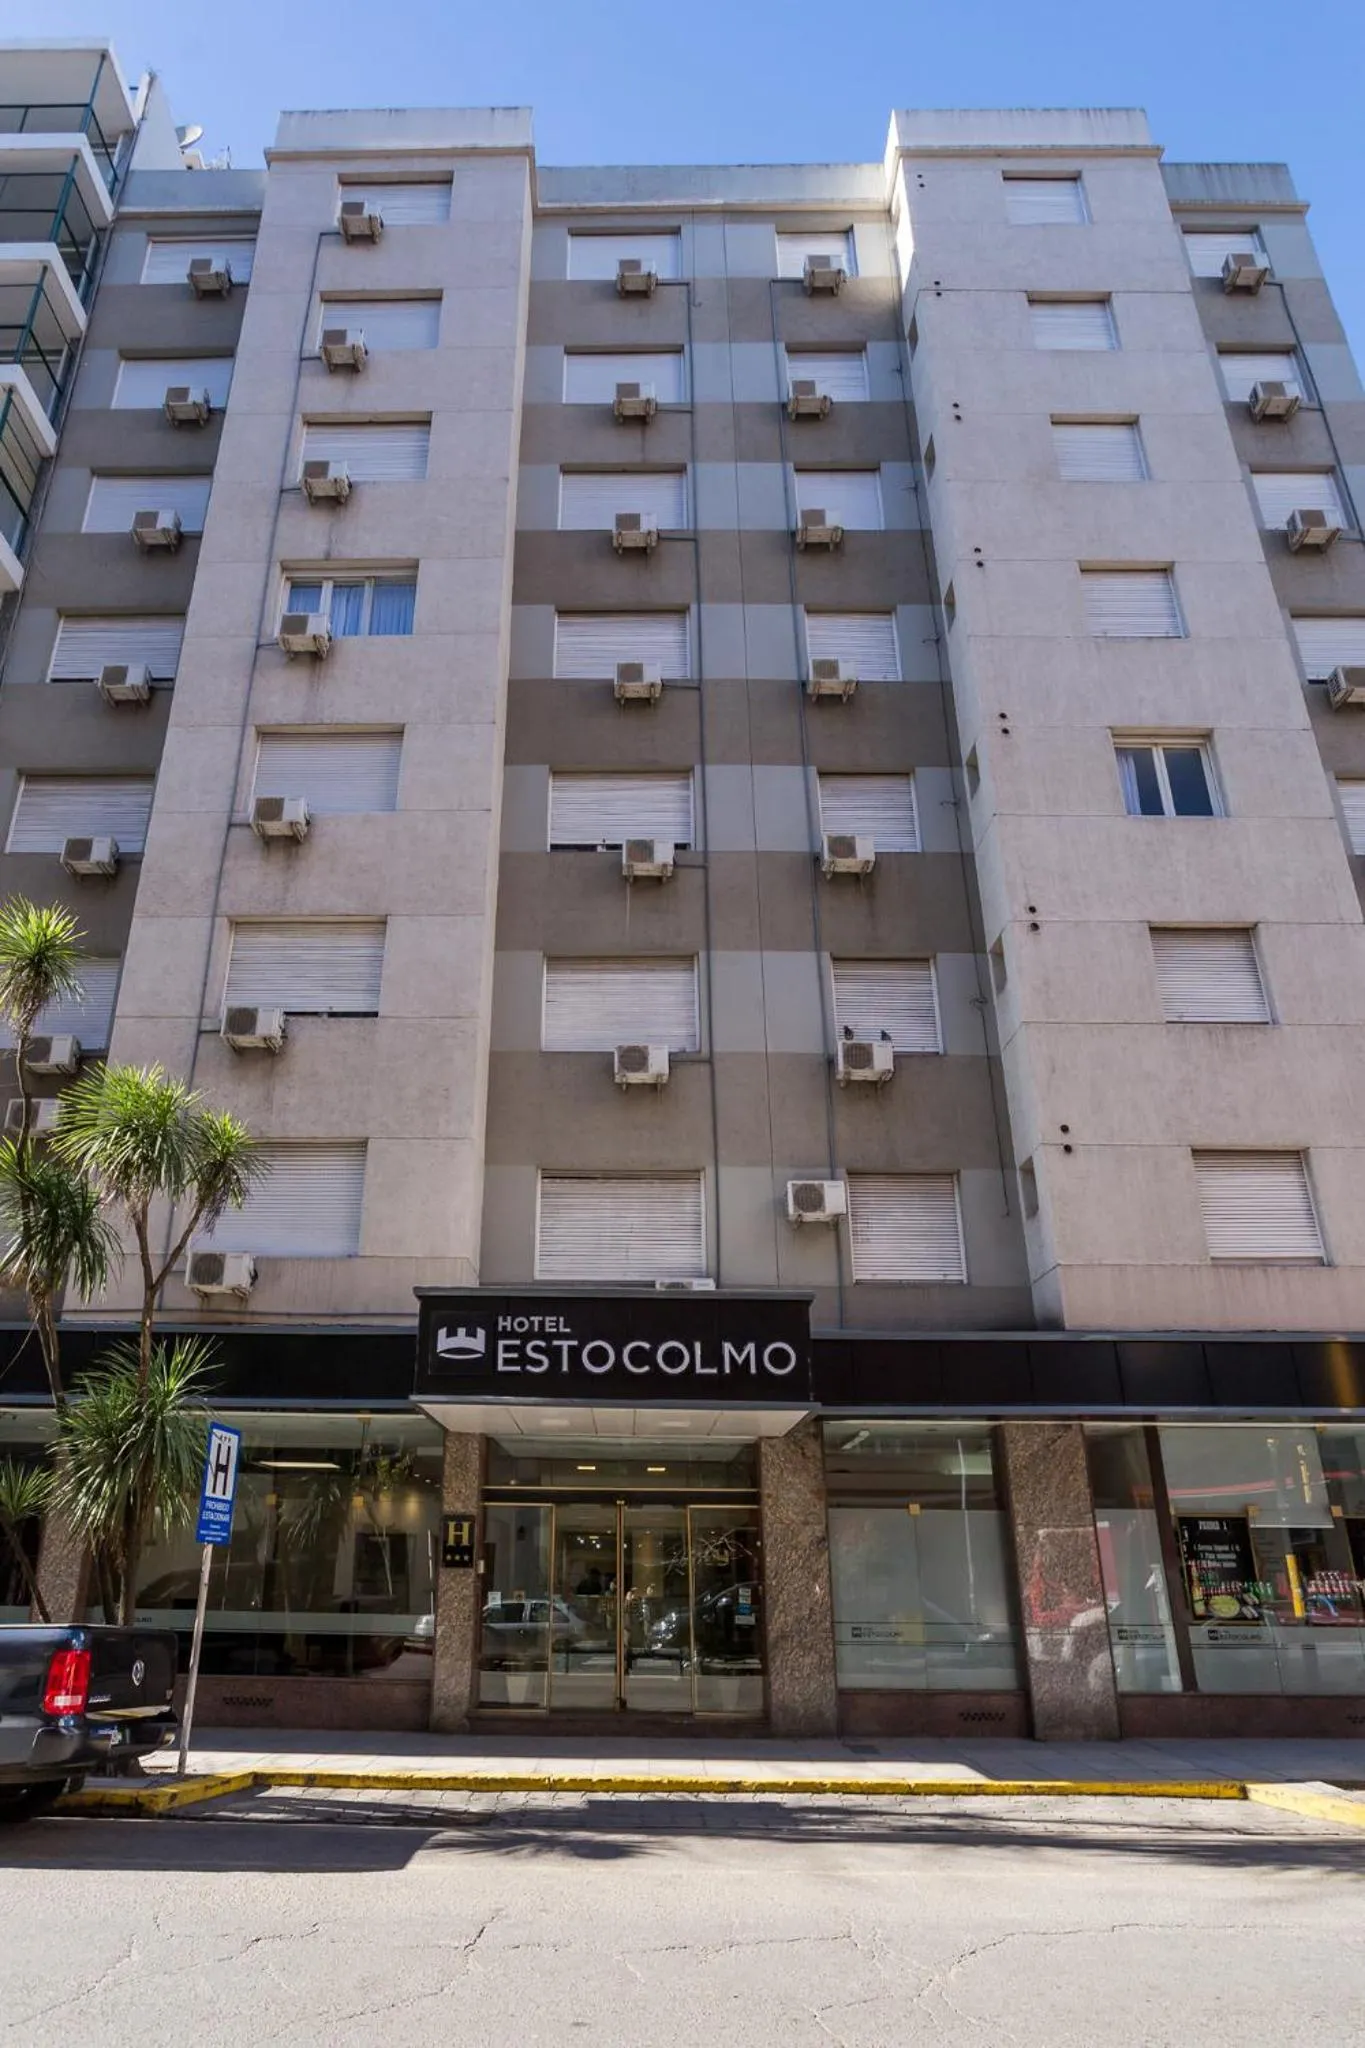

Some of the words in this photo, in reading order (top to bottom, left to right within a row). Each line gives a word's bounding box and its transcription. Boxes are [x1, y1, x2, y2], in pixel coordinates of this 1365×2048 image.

[497, 1315, 571, 1333] HOTEL
[497, 1339, 797, 1375] ESTOCOLMO
[212, 1443, 231, 1495] H
[447, 1521, 472, 1546] H
